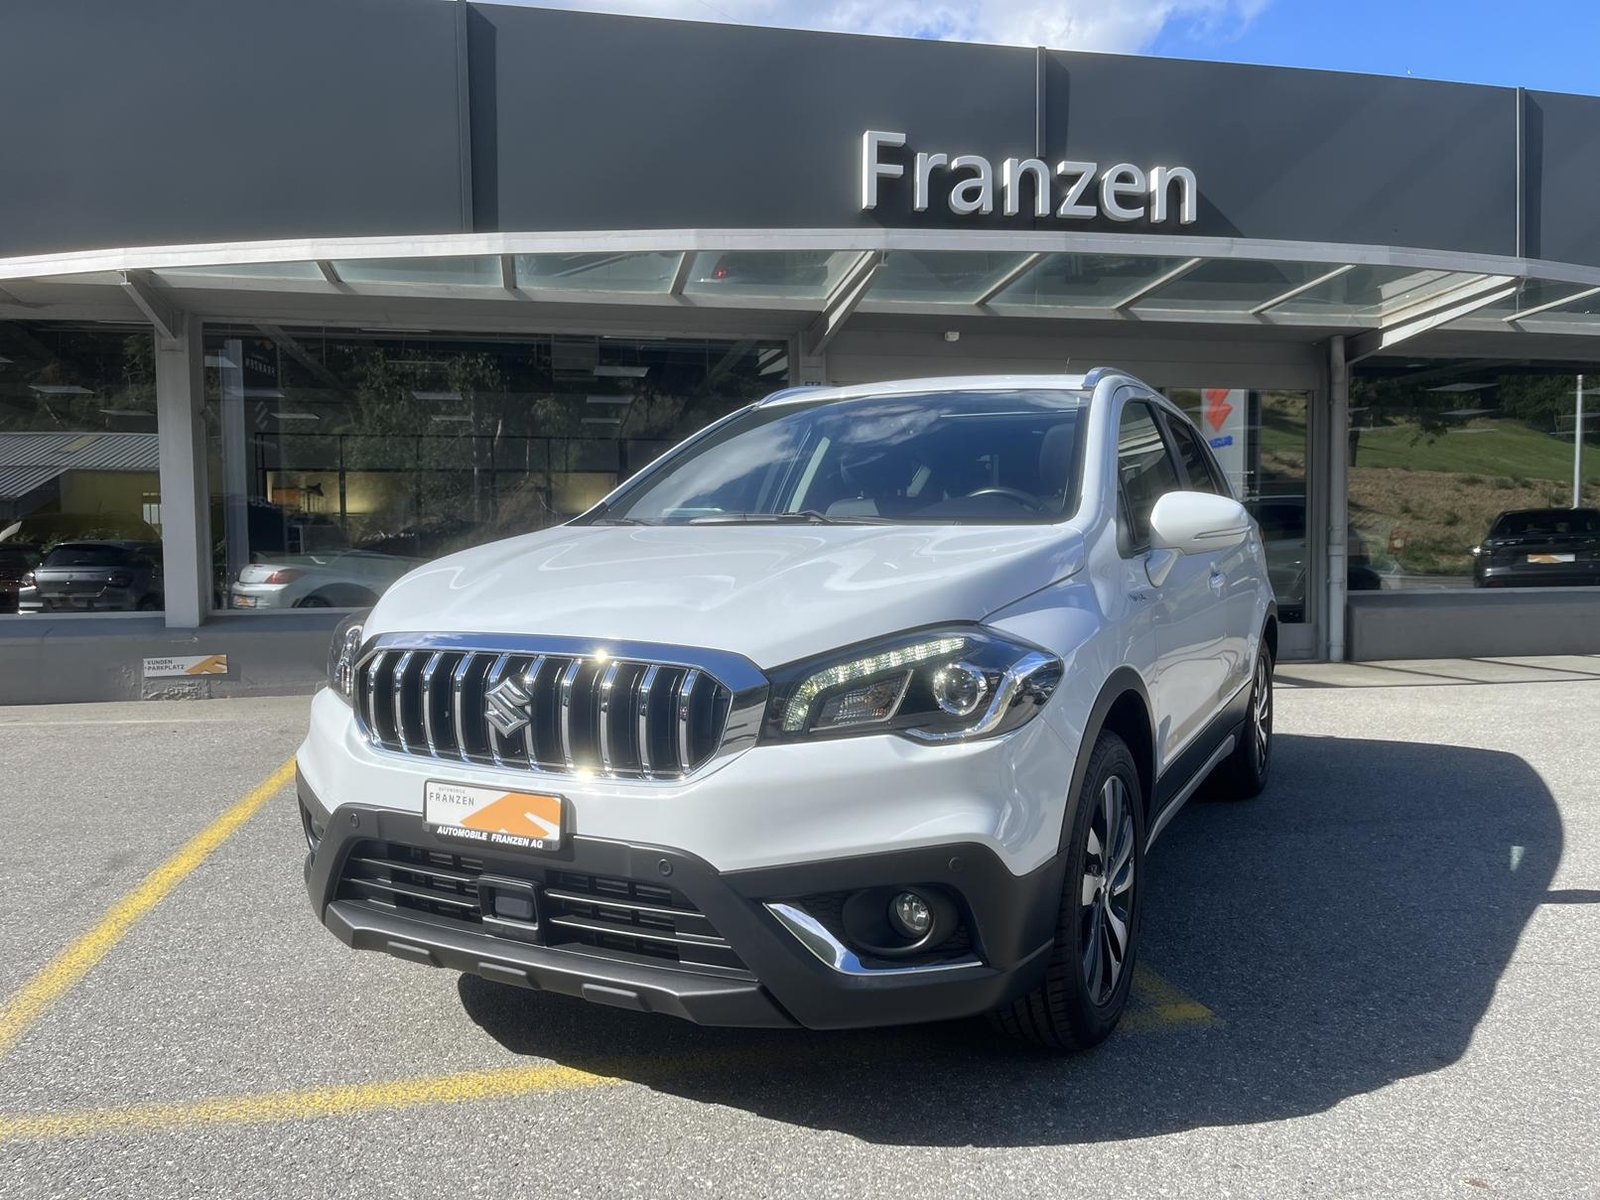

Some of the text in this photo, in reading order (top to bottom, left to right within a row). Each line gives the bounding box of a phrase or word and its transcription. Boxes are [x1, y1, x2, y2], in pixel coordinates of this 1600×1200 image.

[862, 130, 1197, 225] Franzen
[429, 792, 475, 806] FRANZEN
[436, 825, 544, 849] AUTOMOBILE FRANZEN AG
